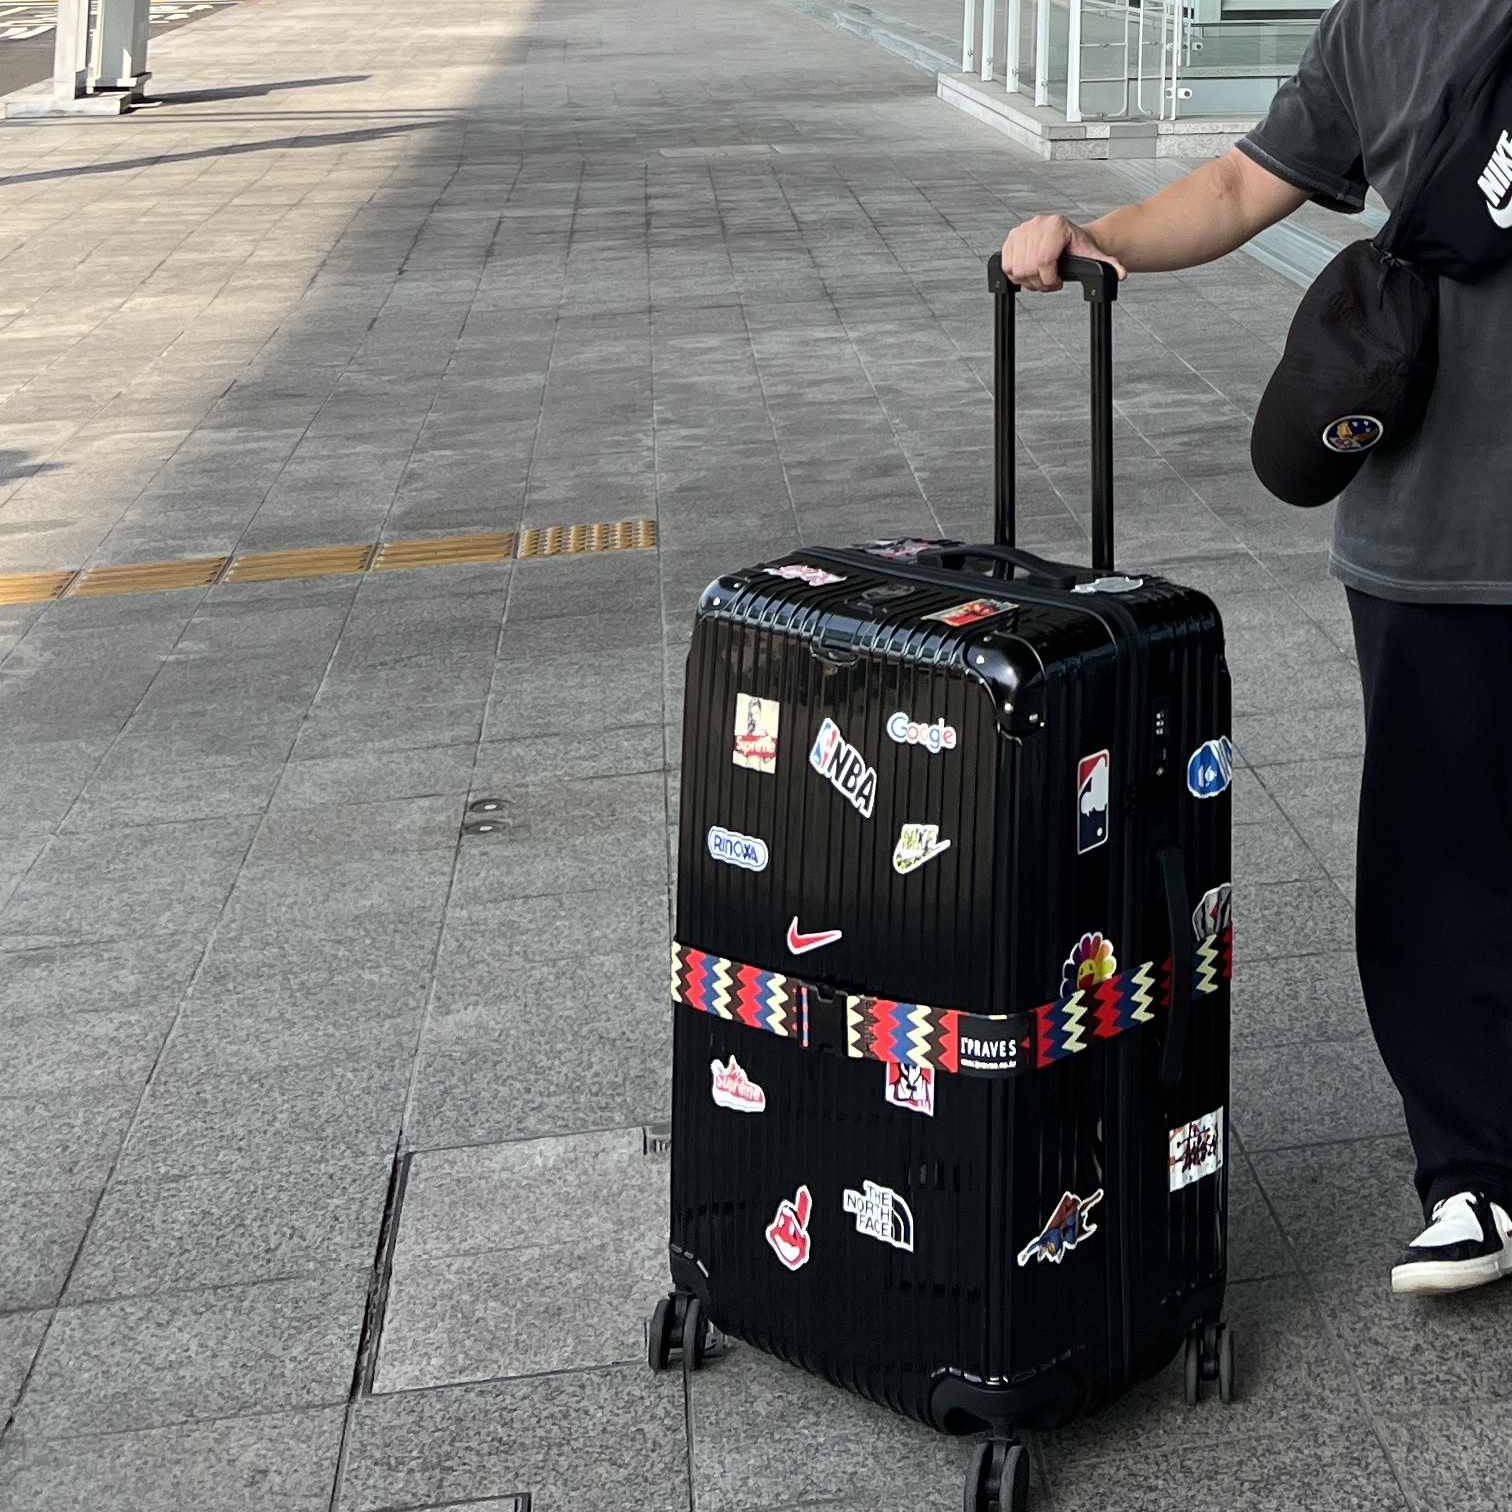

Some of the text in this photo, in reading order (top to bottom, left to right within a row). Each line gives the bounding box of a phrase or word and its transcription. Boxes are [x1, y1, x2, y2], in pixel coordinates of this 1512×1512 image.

[891, 715, 954, 749] Google
[826, 740, 876, 812] NBA
[846, 1193, 890, 1221] NORTH
[867, 1184, 889, 1207] THE
[859, 1213, 890, 1237] FACE
